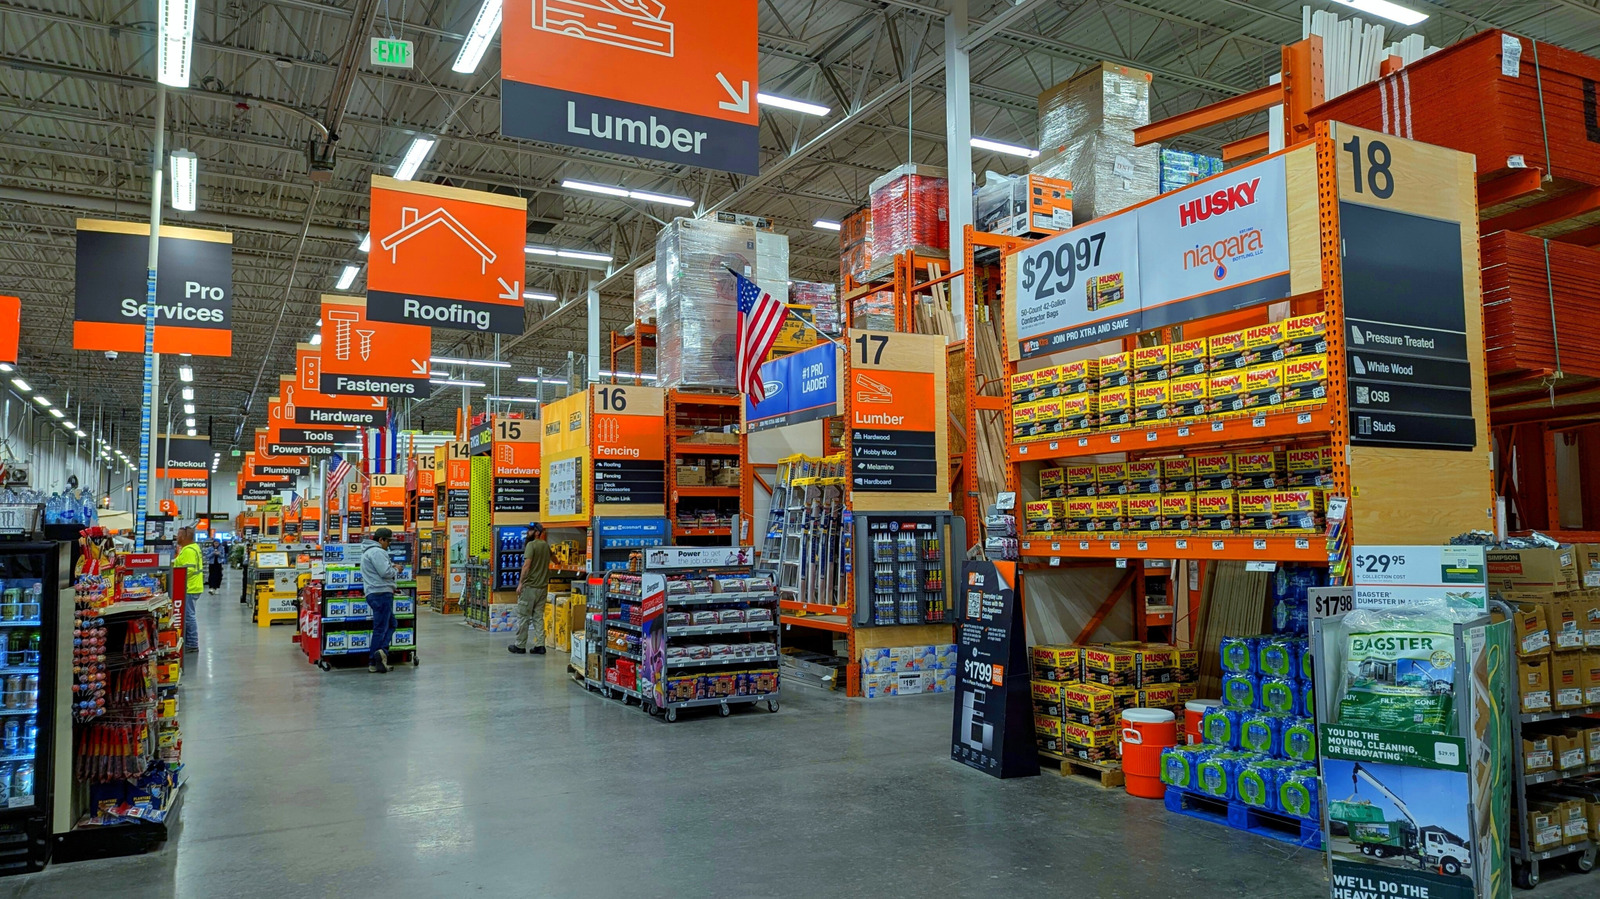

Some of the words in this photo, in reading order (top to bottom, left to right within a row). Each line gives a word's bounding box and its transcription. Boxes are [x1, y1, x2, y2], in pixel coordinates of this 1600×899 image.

[378, 40, 407, 64] EXIT
[567, 101, 707, 154] Lumber
[1343, 135, 1395, 200] 18
[1179, 178, 1260, 227] HUSKY
[1184, 230, 1263, 280] niagara
[185, 281, 224, 300] Pro
[121, 298, 224, 322] Services
[404, 298, 490, 330] Roofing
[1021, 304, 1042, 317] 50-Count
[1043, 298, 1066, 312] 42-Gallon
[1022, 313, 1046, 326] Contractor
[1046, 311, 1059, 320] Bags
[1287, 316, 1324, 330] HUSKY
[1052, 332, 1066, 345] JOIN
[1066, 330, 1079, 341] PRO
[1080, 326, 1096, 338] XTRA
[1098, 324, 1110, 335] AND
[1112, 319, 1129, 331] SAVE
[1030, 340, 1039, 349] Pro
[1366, 331, 1402, 346] Pressure
[1404, 336, 1434, 348] Treated
[856, 334, 888, 364] 17
[1136, 348, 1164, 360] HUSKY
[802, 367, 810, 379] #1
[810, 362, 823, 378] PRO
[1367, 361, 1390, 373] White
[1390, 364, 1413, 375] Wood
[337, 377, 415, 392] Fasteners
[802, 376, 827, 394] LADDER
[1013, 373, 1034, 384] HUSKY
[1210, 376, 1240, 388] HUSKY
[598, 388, 626, 411] 16
[1065, 398, 1085, 408] HUSKY
[1370, 391, 1390, 402] OSB
[310, 410, 373, 422] Hardware
[856, 411, 904, 425] Lumber
[498, 421, 521, 440] 15
[1373, 421, 1396, 432] Studs
[304, 431, 334, 440] Tools
[272, 446, 303, 454] Power
[306, 446, 332, 454] Tools
[452, 443, 469, 458] 14
[598, 446, 640, 457] Fencing
[168, 460, 206, 468] Checkout
[420, 456, 435, 469] 13
[1198, 456, 1228, 466] HUSKY
[263, 467, 300, 475] Plumbing
[498, 466, 540, 474] Hardware
[1069, 468, 1092, 476] HUSKY
[373, 476, 387, 486] 10
[351, 484, 357, 492] 9
[163, 501, 170, 510] 3
[1096, 500, 1118, 509] HUSKY
[710, 550, 720, 558] get
[975, 572, 984, 583] Pro
[1353, 638, 1434, 651] BAGSTER
[1034, 651, 1054, 659] HUSKY
[1145, 653, 1171, 662] HUSKY
[965, 659, 992, 682] $1799
[1067, 691, 1089, 702] HUSKY
[1328, 728, 1345, 736] YOU
[1347, 730, 1359, 738] DO
[1361, 732, 1379, 740] THE
[1328, 737, 1366, 749] MOVING,
[1368, 742, 1418, 754] CLEANING,
[1342, 746, 1403, 761] RENOVATING.
[1334, 875, 1377, 890] WE'LL
[1380, 881, 1398, 892] DO
[1400, 884, 1428, 898] THE
